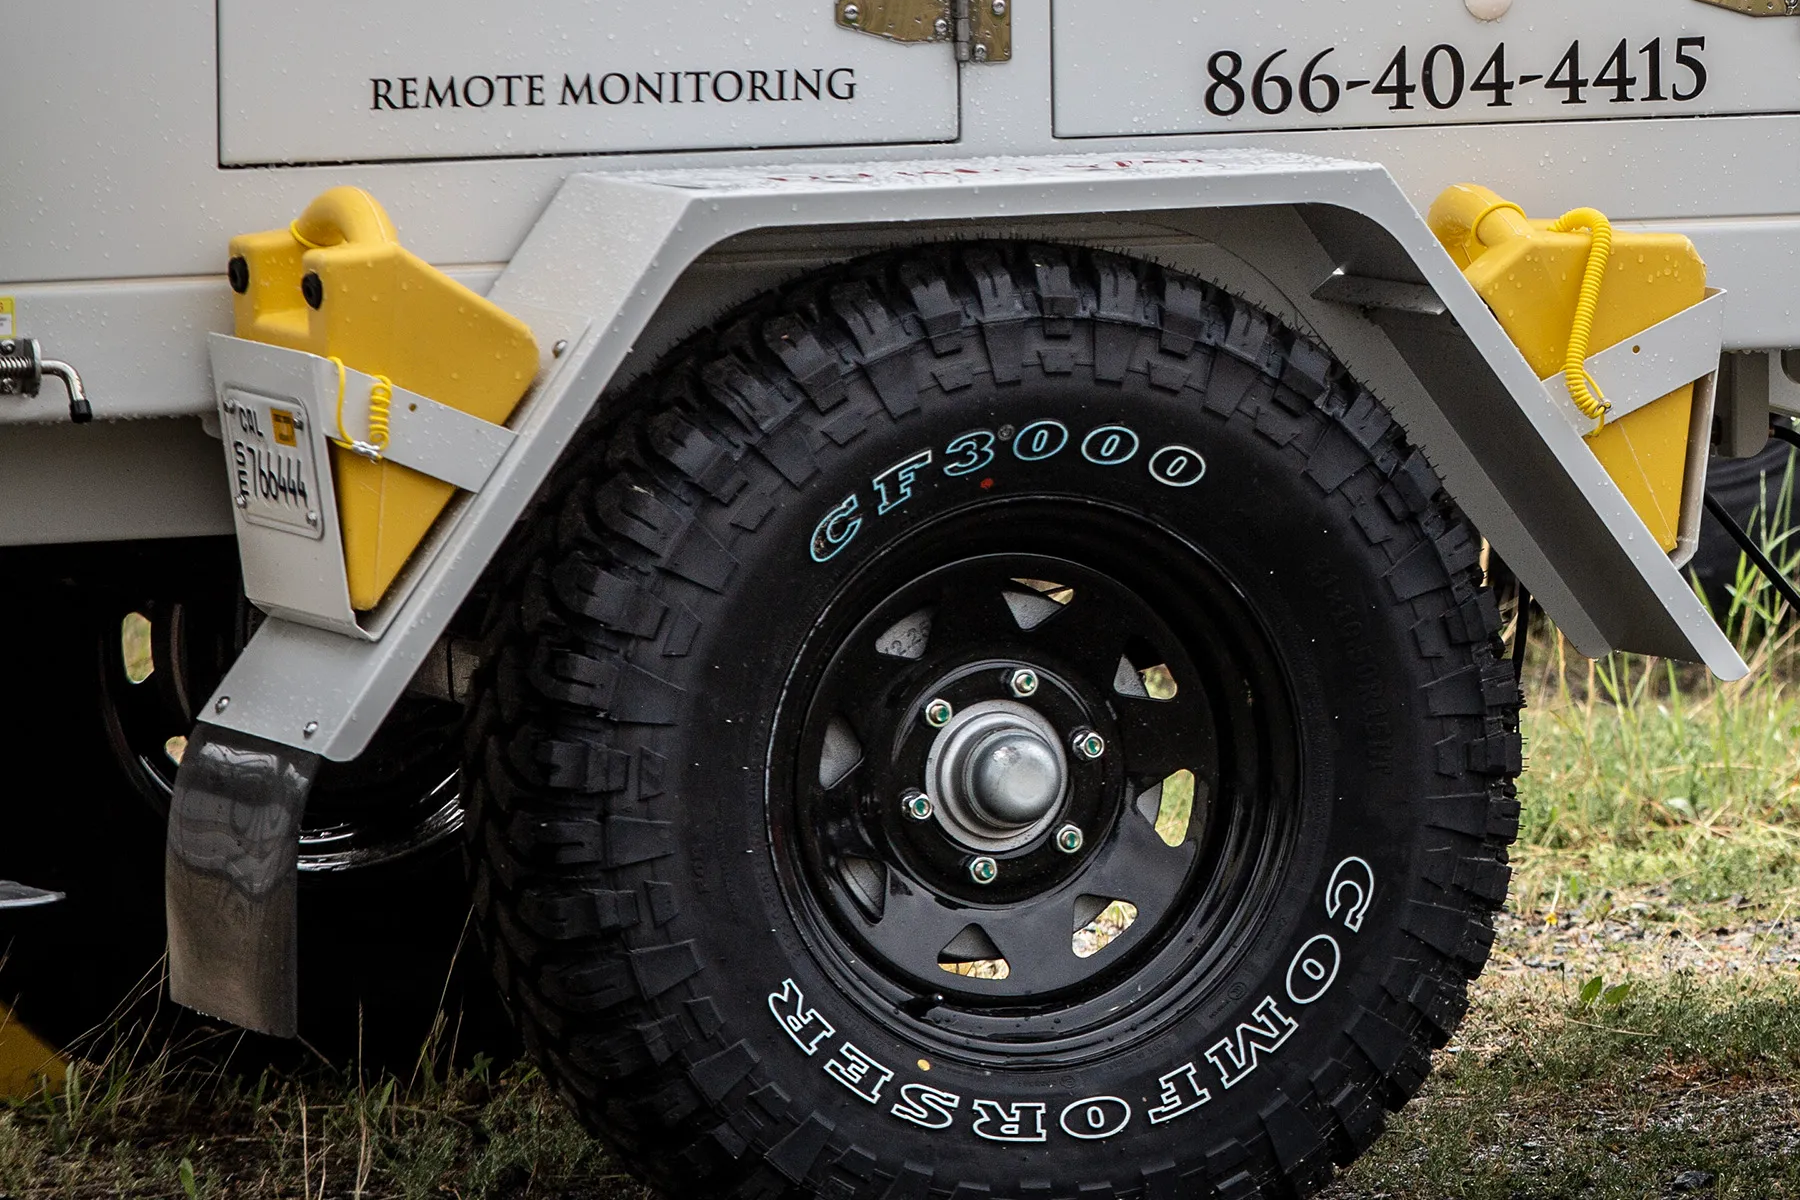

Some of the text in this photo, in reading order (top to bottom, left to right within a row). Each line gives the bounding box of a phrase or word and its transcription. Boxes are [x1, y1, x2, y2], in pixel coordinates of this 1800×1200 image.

[369, 67, 858, 111] REMOTE MONITORING
[1203, 35, 1709, 118] 866-404-4415
[239, 407, 264, 437] CAL
[246, 446, 309, 510] 766444
[767, 855, 1376, 1144] COMFORSER
